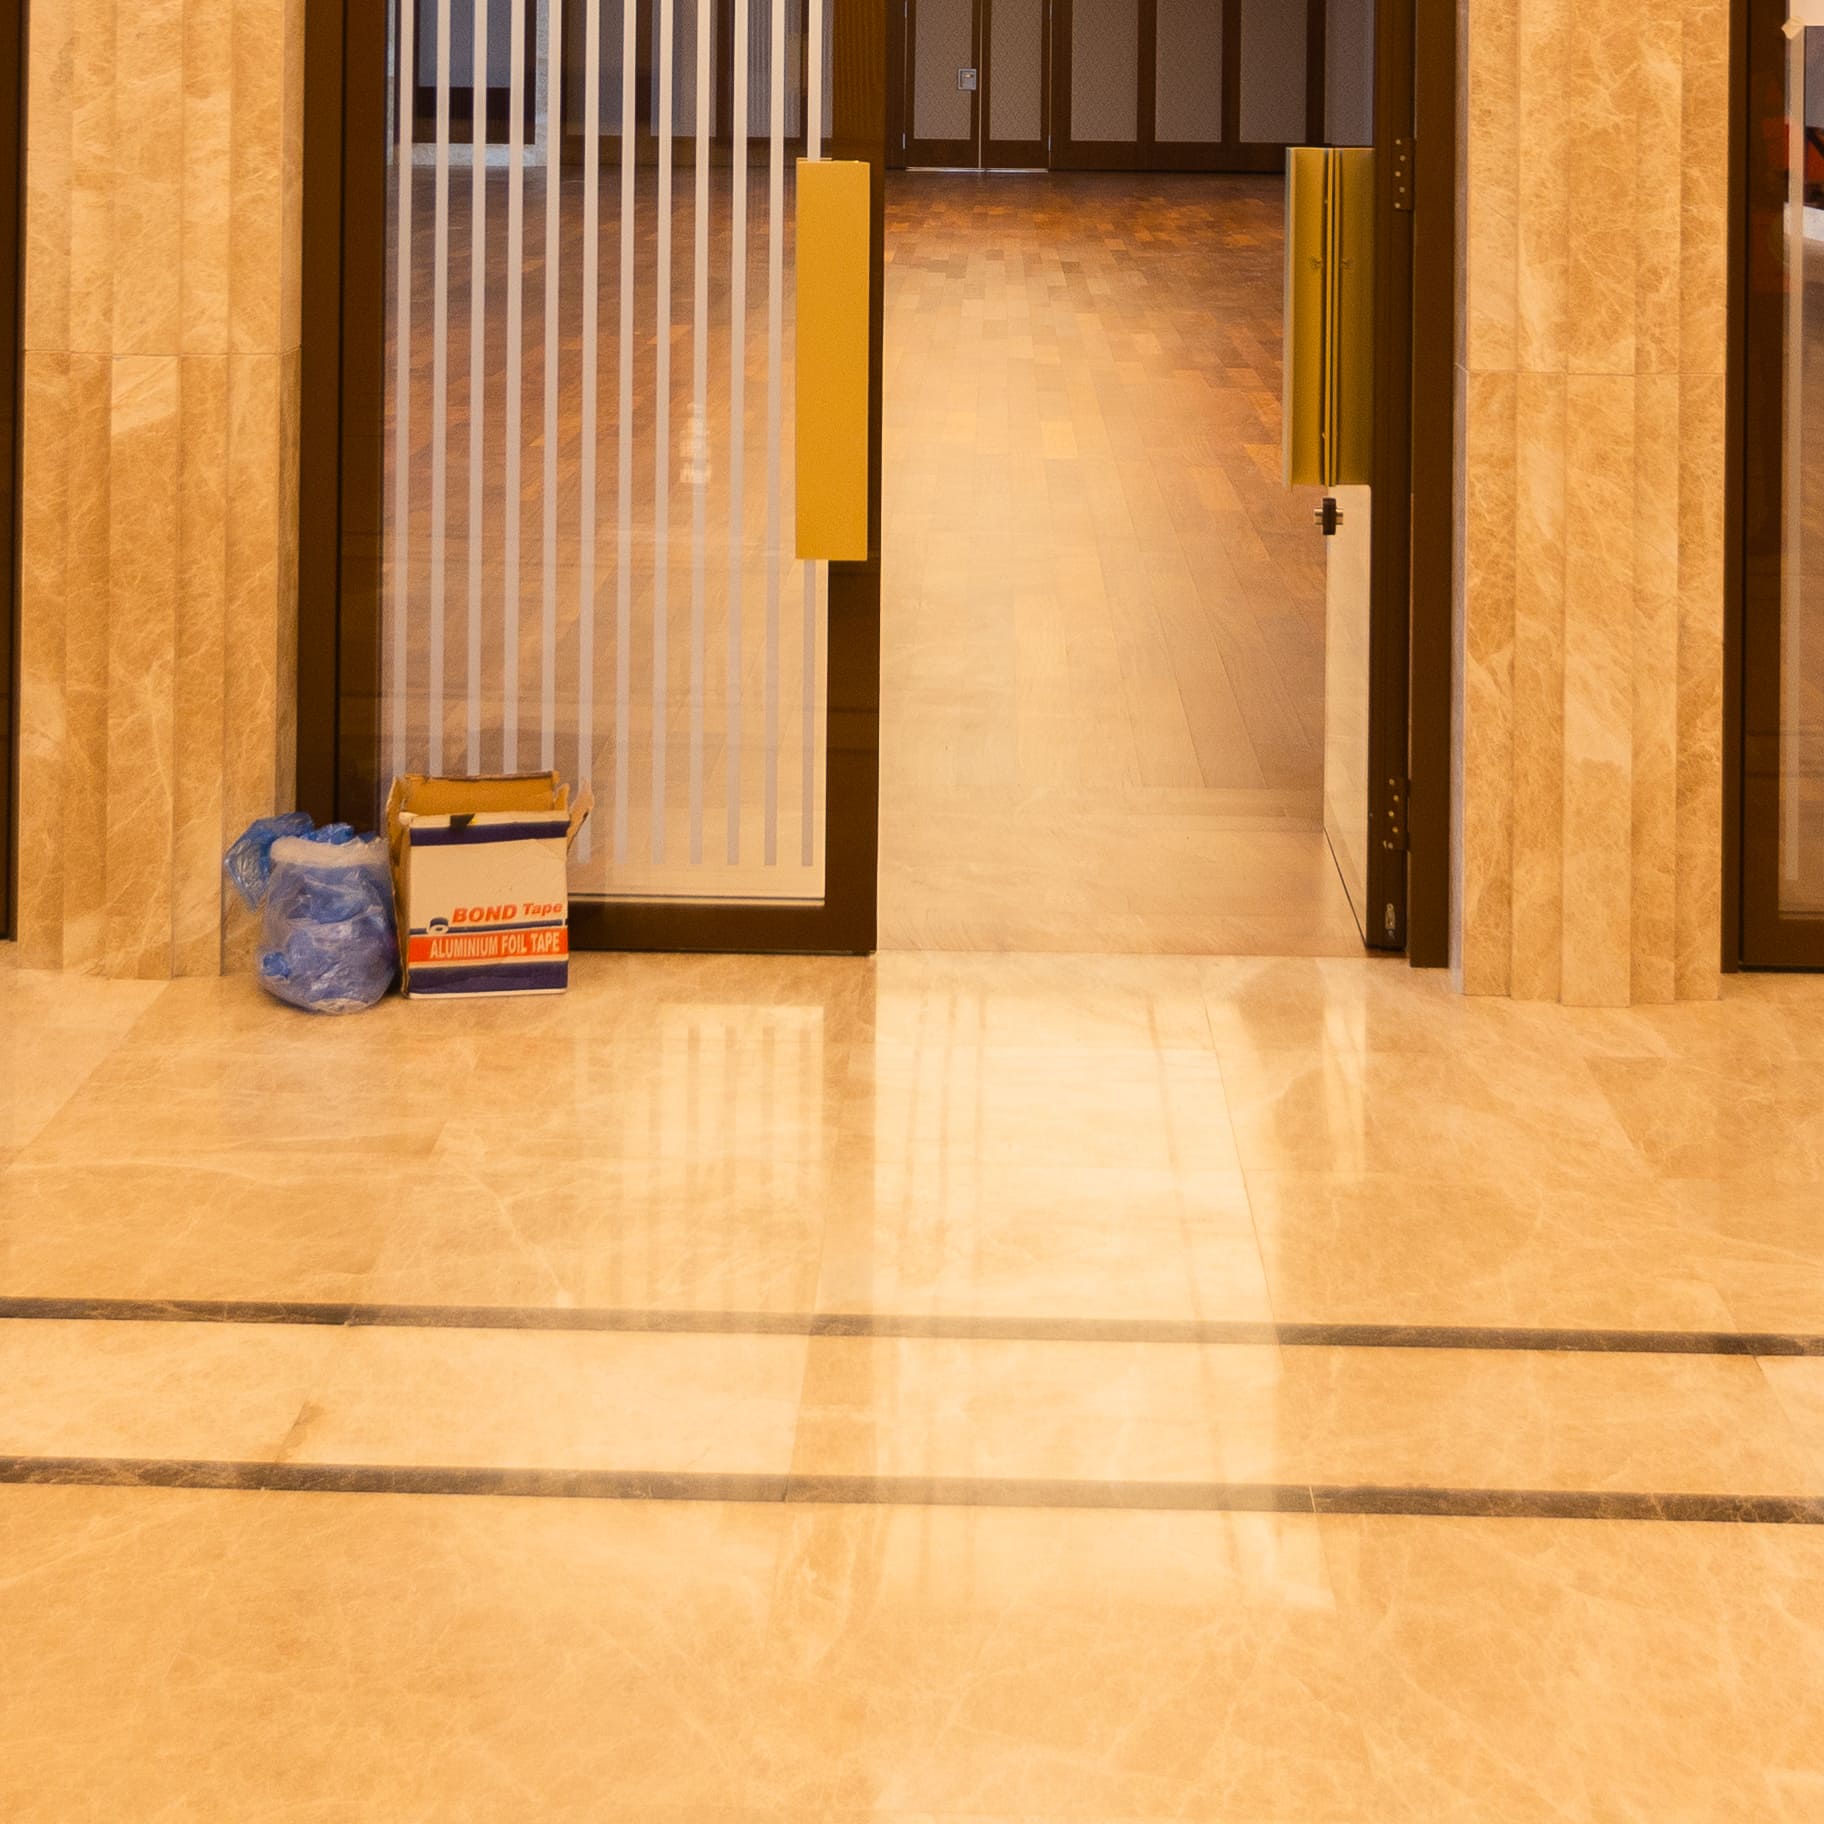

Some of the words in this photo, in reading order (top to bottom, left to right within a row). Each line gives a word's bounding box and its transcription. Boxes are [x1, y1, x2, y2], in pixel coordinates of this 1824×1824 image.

[452, 904, 518, 923] BOND
[522, 902, 563, 916] Tape
[429, 935, 498, 959] ALUMINIUM
[501, 933, 527, 954] FOIL
[530, 932, 560, 952] TAPE
